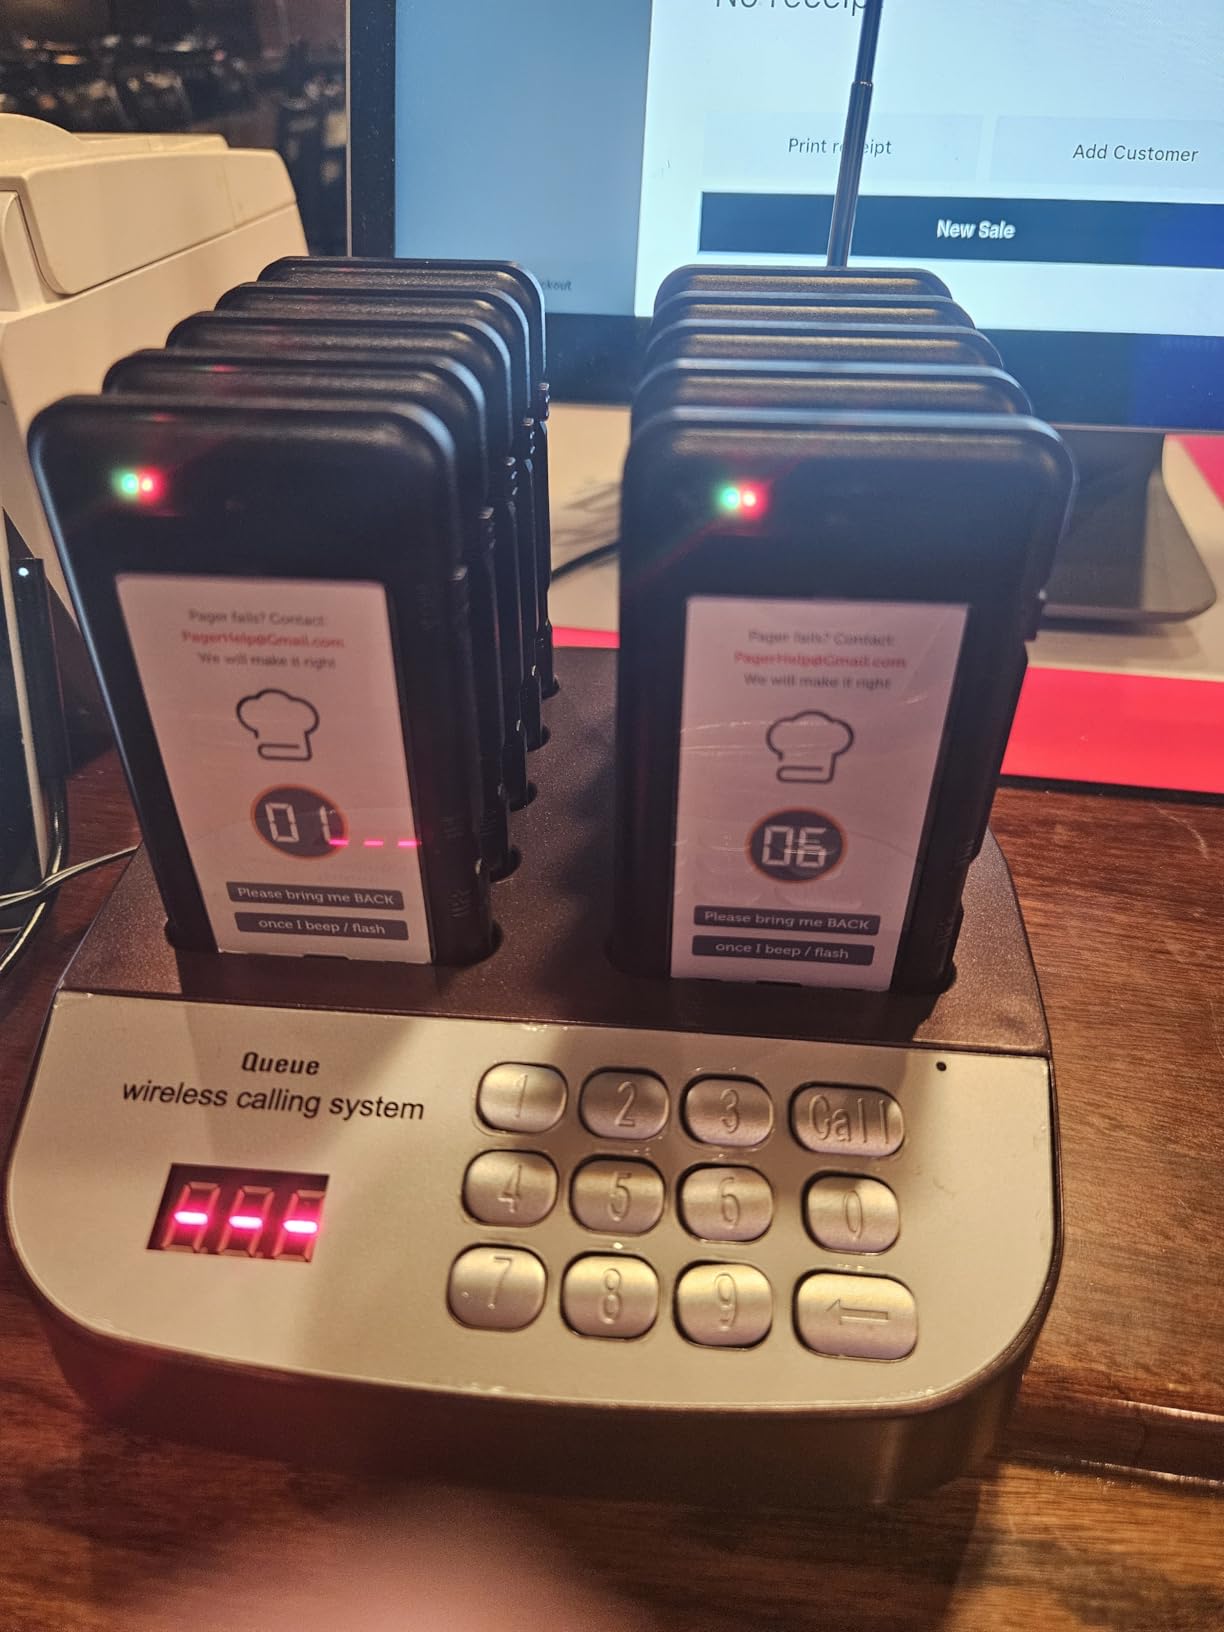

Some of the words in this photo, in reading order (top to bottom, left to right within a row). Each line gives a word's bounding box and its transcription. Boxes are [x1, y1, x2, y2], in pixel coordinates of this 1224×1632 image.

[788, 138, 827, 153] Print
[833, 139, 892, 158] reipt
[1073, 144, 1108, 159] Add
[1114, 145, 1199, 162] Customer
[937, 219, 976, 238] New
[979, 220, 1016, 239] Sale
[188, 609, 227, 625] Pager
[748, 630, 790, 645] Pager
[199, 652, 220, 665] We
[225, 653, 248, 665] will
[251, 654, 288, 666] make
[291, 655, 301, 667] it
[744, 673, 766, 686] We
[772, 674, 795, 687] will
[800, 675, 840, 688] make
[843, 676, 853, 689] it
[265, 803, 330, 842] 01
[762, 826, 826, 867] 06
[237, 886, 283, 899] Please
[286, 889, 324, 903] bring
[328, 894, 351, 903] me
[354, 893, 394, 905] BACK
[258, 919, 294, 930] once
[305, 920, 340, 934] beep
[352, 922, 386, 935] flash
[704, 910, 751, 922] Please
[755, 913, 795, 928] bring
[799, 918, 824, 928] me
[827, 918, 870, 930] BACK
[715, 943, 752, 953] once
[765, 944, 801, 958] beep
[814, 946, 849, 959] flash
[241, 1051, 320, 1076] Queue
[122, 1080, 229, 1108] wireless
[236, 1088, 321, 1119] calling
[329, 1096, 425, 1121] system
[512, 1073, 529, 1119] 1
[617, 1080, 636, 1127] 2
[720, 1088, 740, 1134] 3
[808, 1093, 891, 1145] Call
[497, 1163, 523, 1213] 4
[607, 1171, 633, 1222] 5
[720, 1177, 740, 1229] 6
[488, 1255, 513, 1310] 7
[599, 1267, 623, 1325] 8
[714, 1272, 738, 1331] 9
